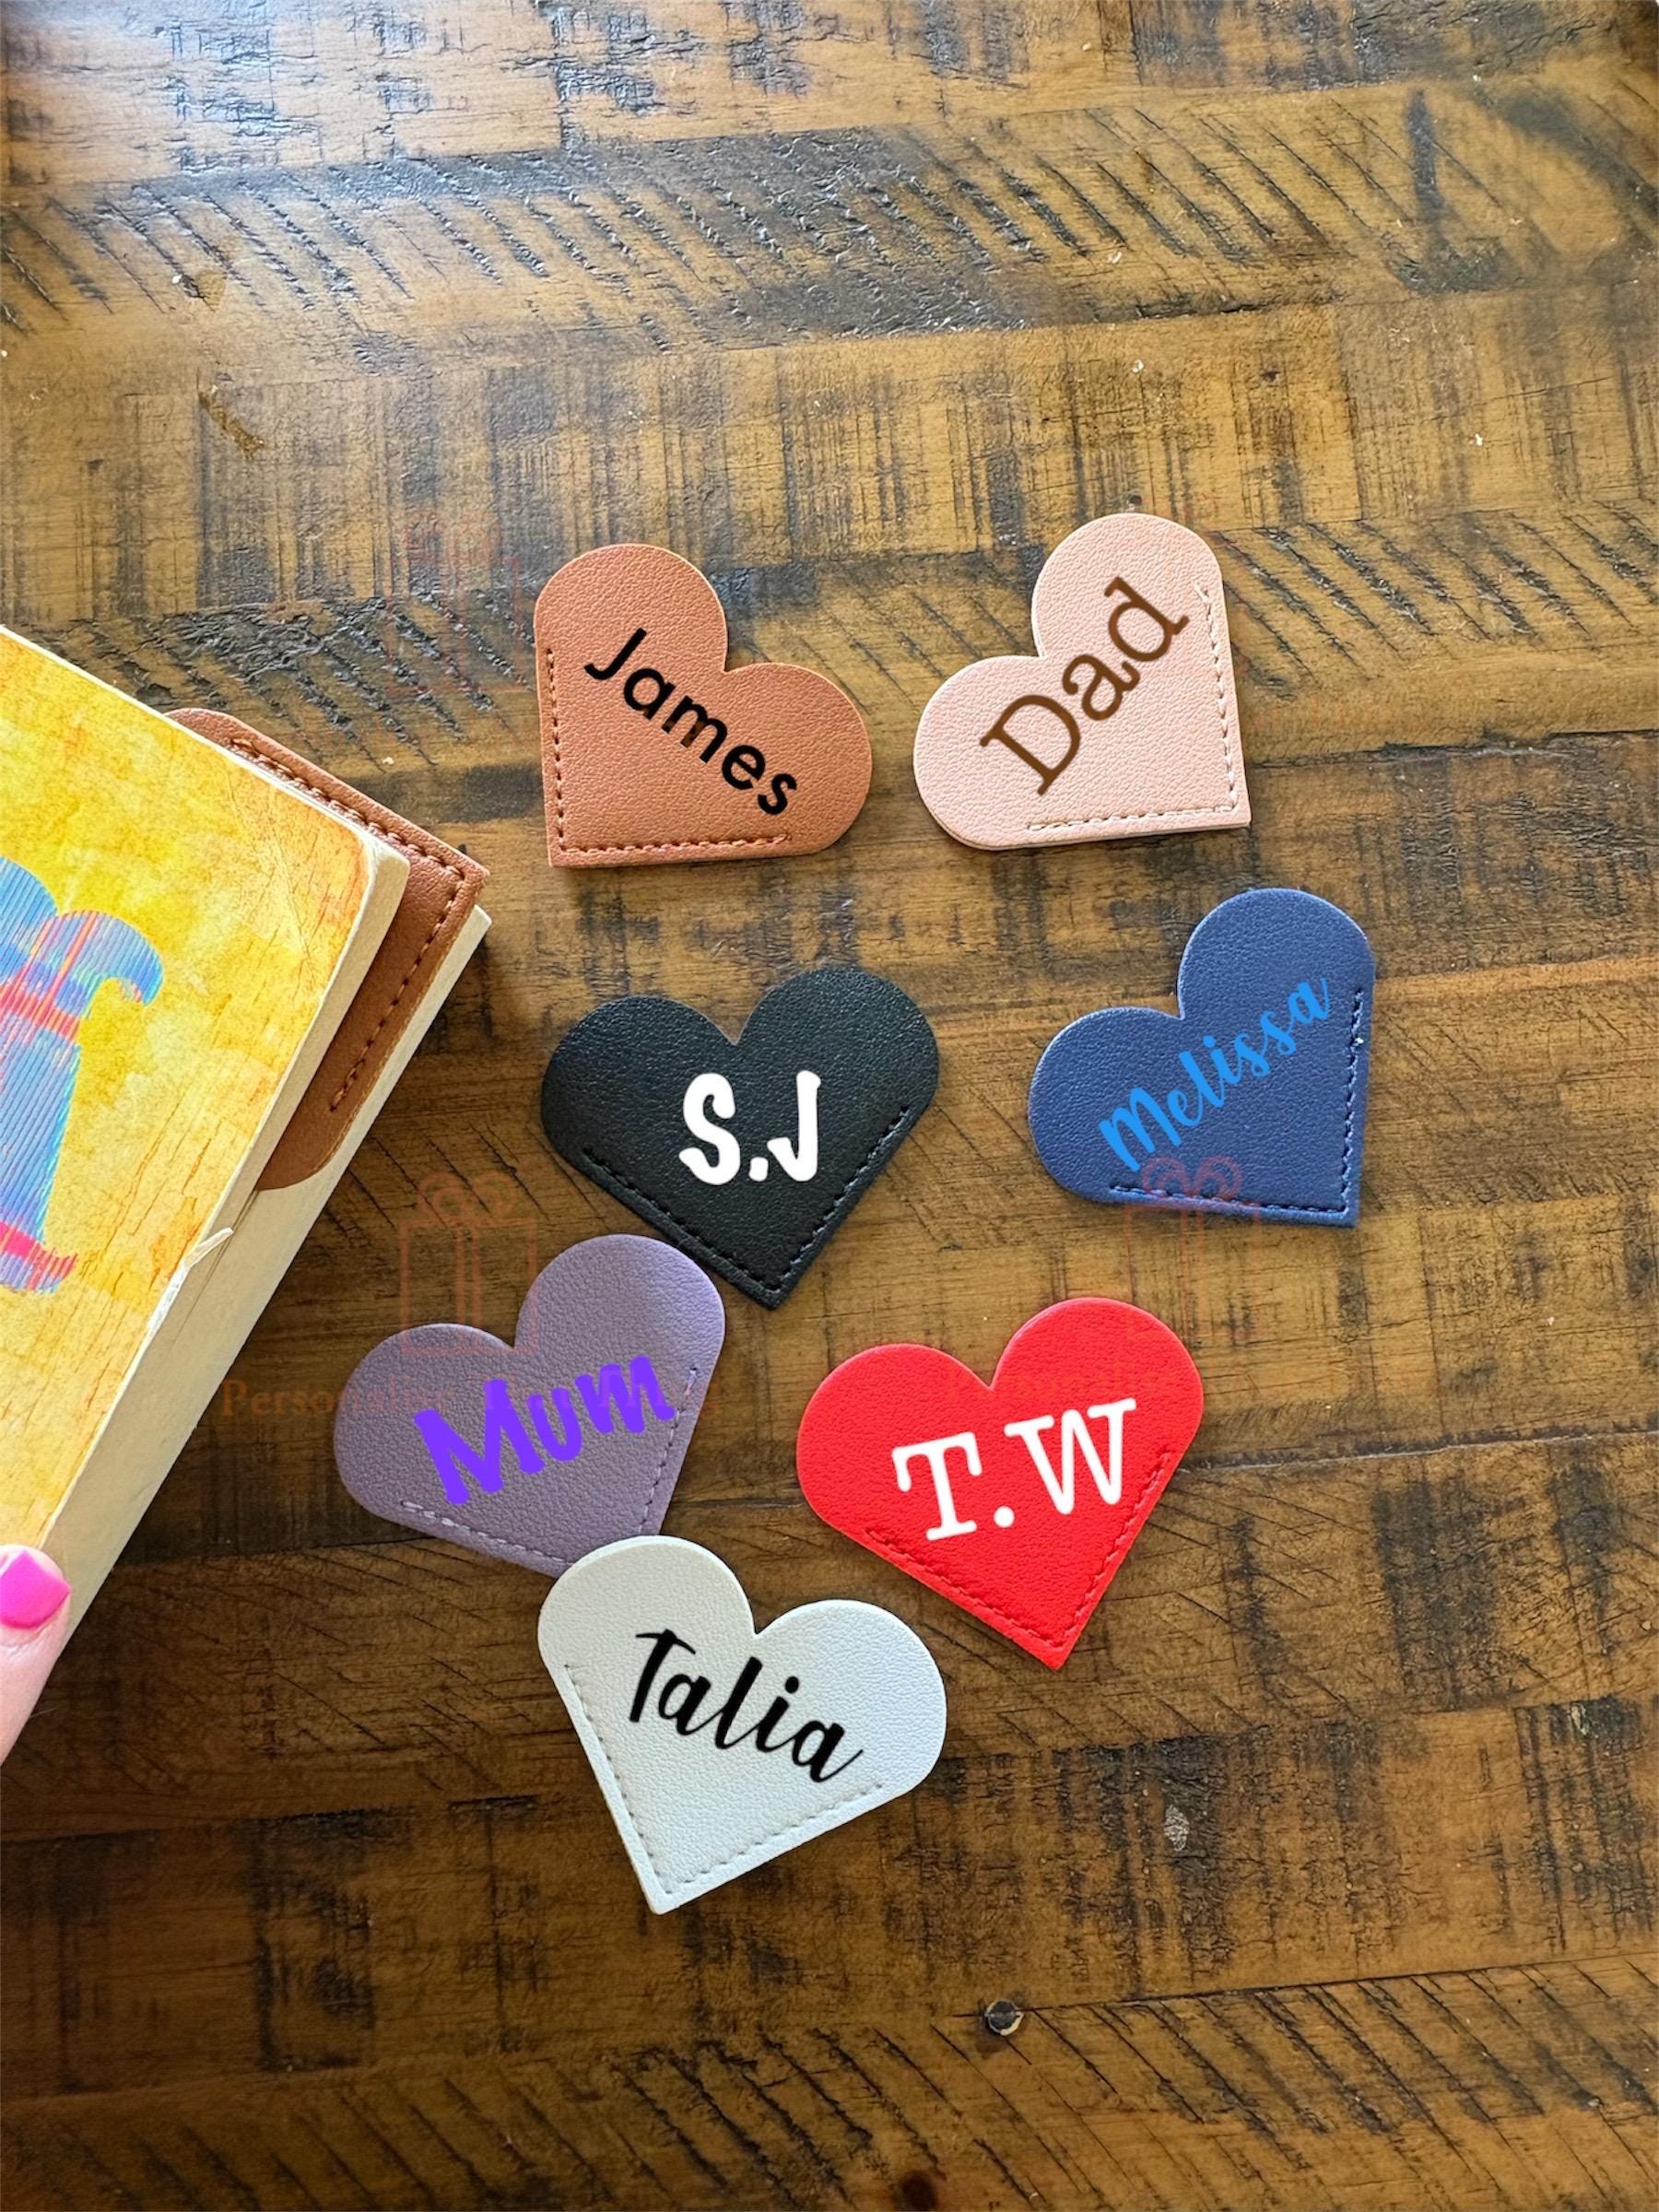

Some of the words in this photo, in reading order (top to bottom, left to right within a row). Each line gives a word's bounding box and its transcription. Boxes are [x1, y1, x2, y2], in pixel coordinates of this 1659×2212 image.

[583, 627, 798, 816] James
[979, 575, 1190, 796] Dad
[678, 1070, 821, 1186] S.J
[1099, 977, 1333, 1172] Melissa
[415, 1356, 677, 1507] Mum
[891, 1397, 1137, 1541] T.W
[629, 1628, 864, 1784] Talia
